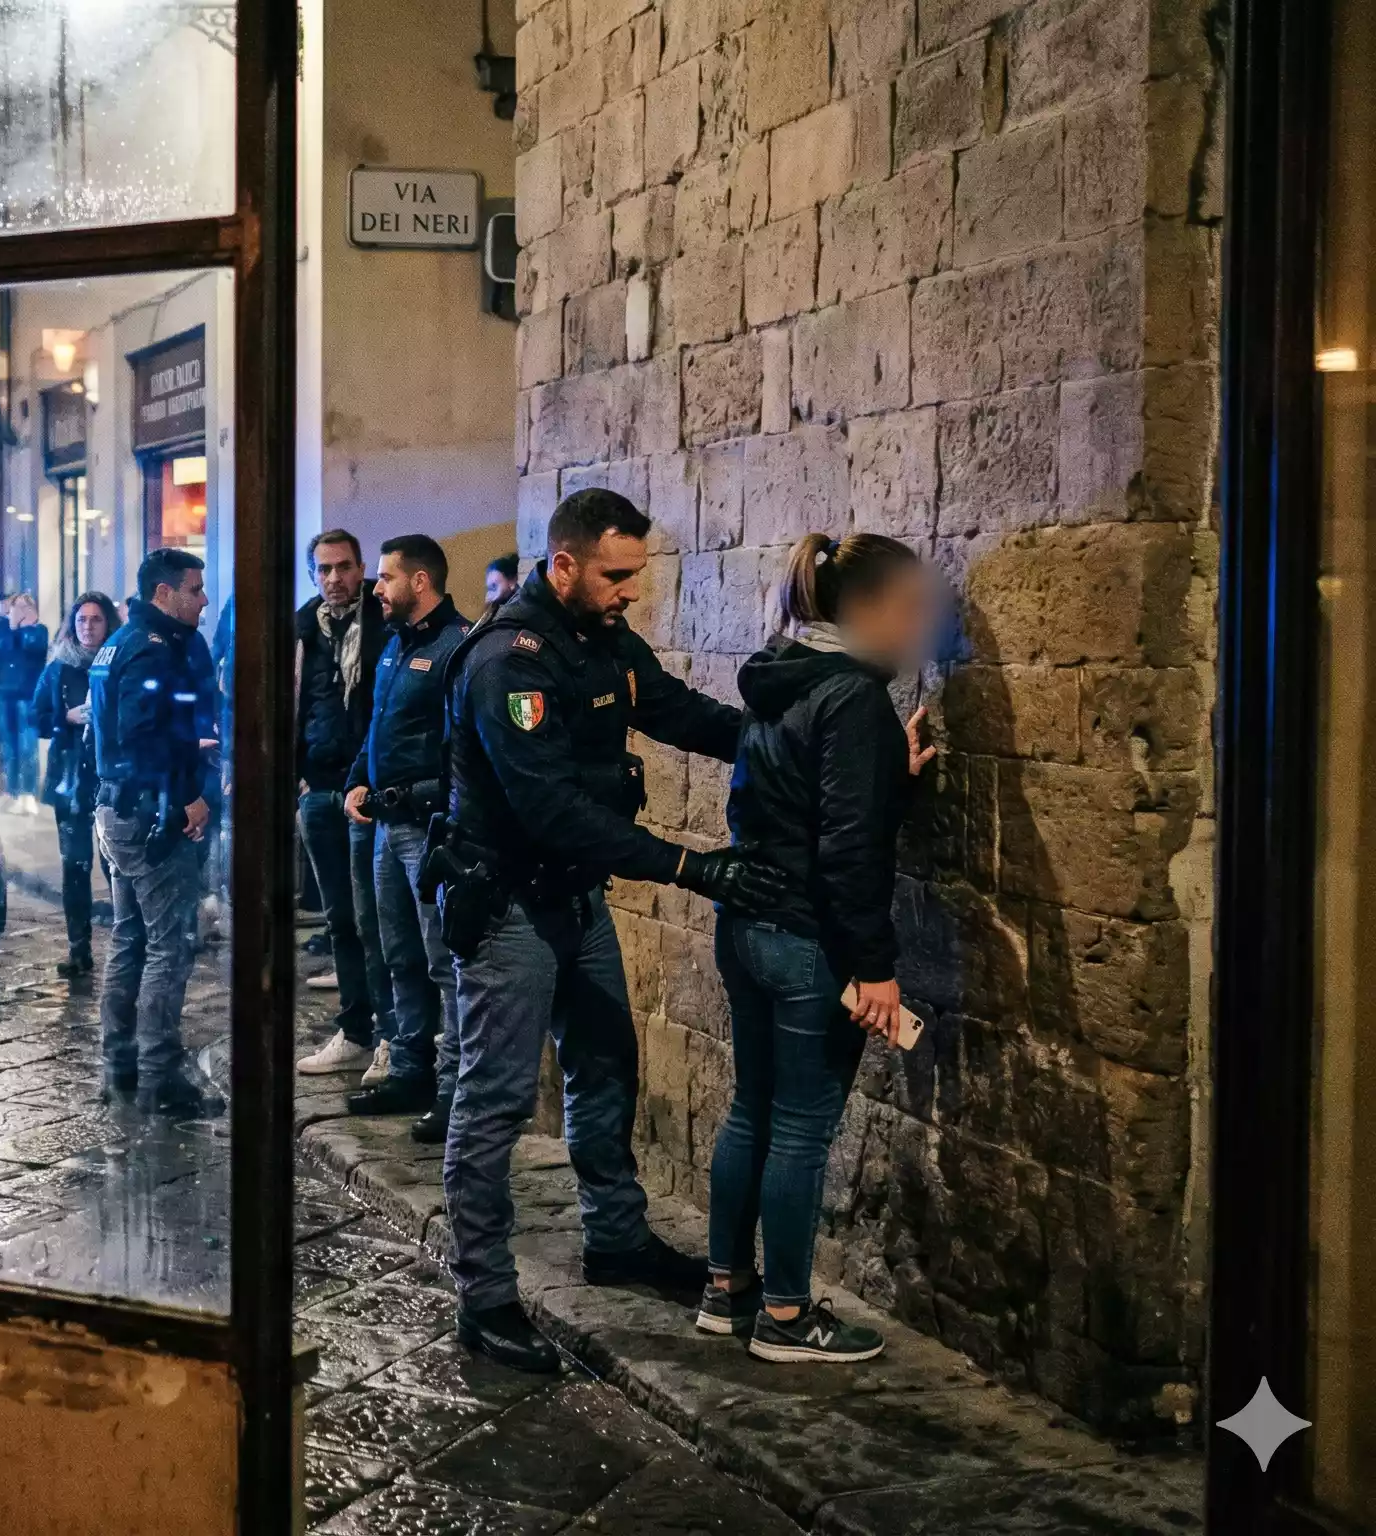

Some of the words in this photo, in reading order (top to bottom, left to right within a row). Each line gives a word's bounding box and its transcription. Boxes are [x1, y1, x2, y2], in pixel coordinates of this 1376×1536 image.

[395, 183, 436, 203] VIA
[361, 212, 399, 231] DEI
[413, 214, 468, 234] NERI
